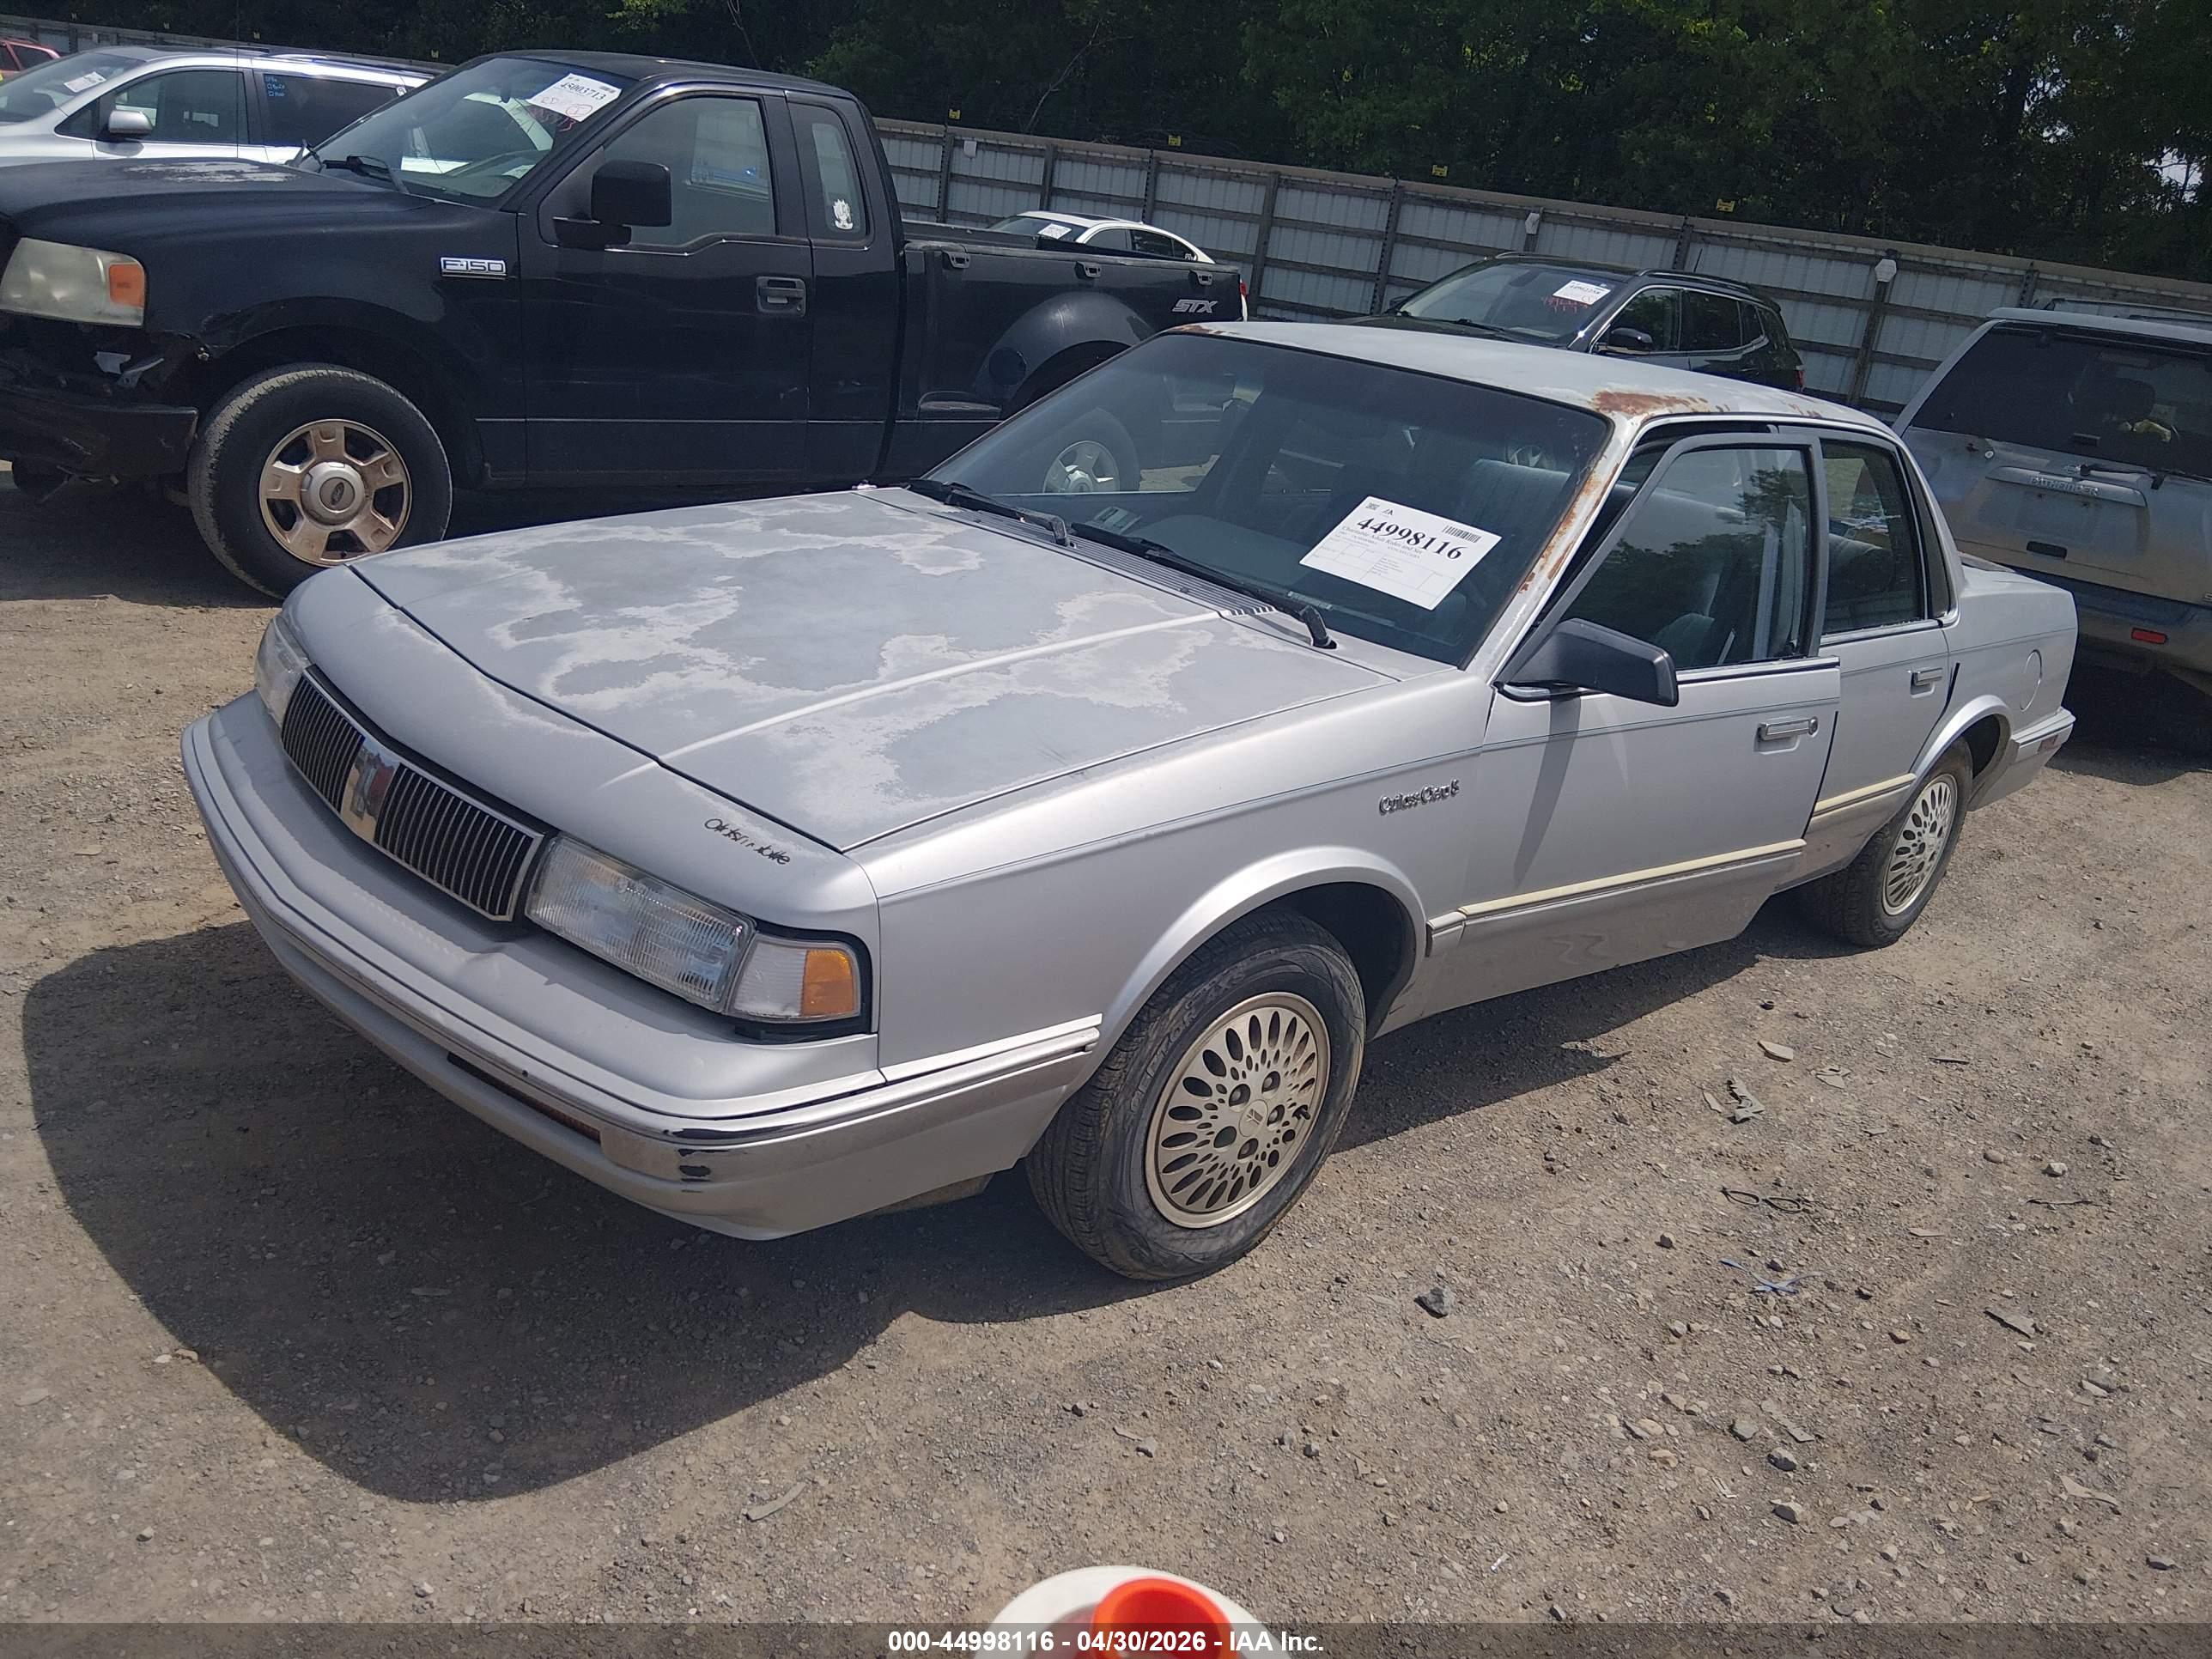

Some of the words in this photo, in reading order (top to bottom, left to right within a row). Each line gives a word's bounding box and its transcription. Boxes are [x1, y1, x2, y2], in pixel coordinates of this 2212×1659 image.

[1171, 299, 1218, 313] STX
[2028, 475, 2100, 496] PATHFINDER
[1357, 518, 1468, 560] 44998116
